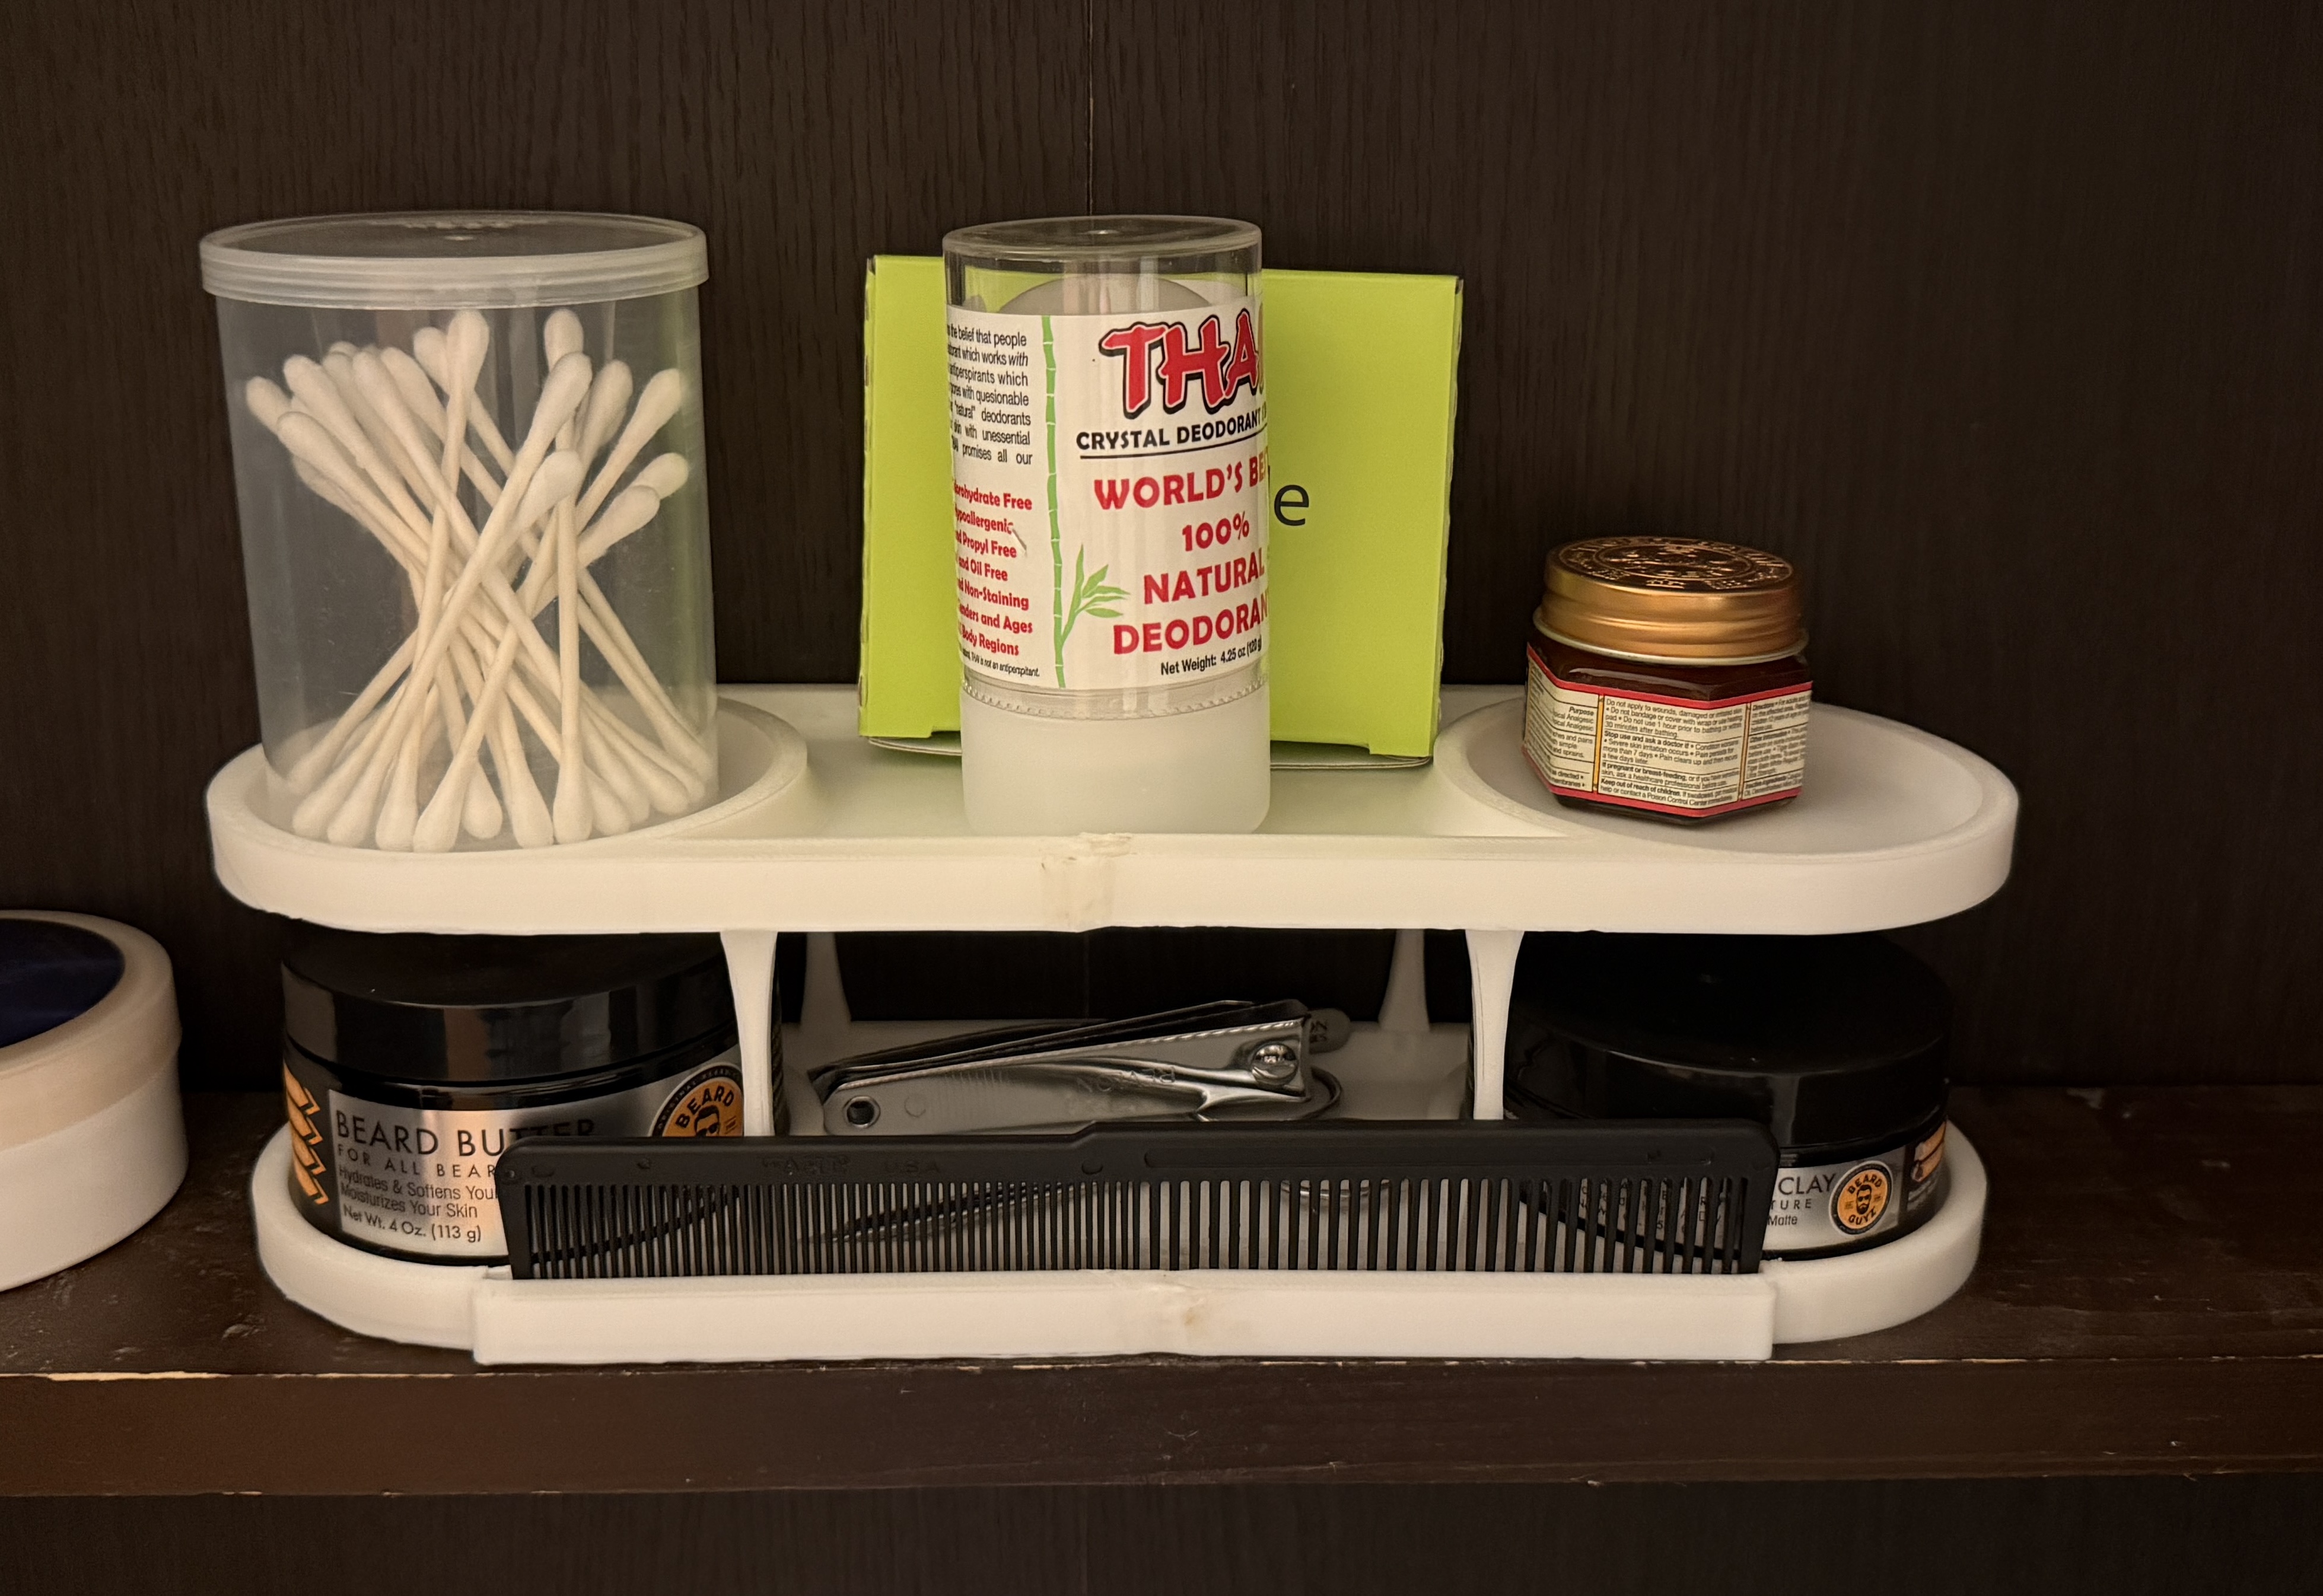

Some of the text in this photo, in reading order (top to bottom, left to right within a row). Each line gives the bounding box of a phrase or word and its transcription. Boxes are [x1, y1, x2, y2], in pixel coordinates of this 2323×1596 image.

[976, 328, 991, 344] that
[994, 332, 1027, 349] people
[962, 346, 980, 362] which
[981, 350, 1007, 365] works
[1008, 352, 1028, 367] with
[998, 371, 1028, 386] which
[962, 384, 1029, 406] with quesionable
[981, 407, 1031, 426] deodorants
[965, 423, 1030, 445] with unessential
[1076, 428, 1170, 450] CRYSTAL
[1177, 408, 1261, 444] DEODORANT
[962, 444, 1033, 465] promises all our
[1094, 461, 1243, 510] WORLD'S
[1003, 492, 1032, 510] Free
[1182, 511, 1250, 552] 100%
[962, 531, 1017, 558] Propyl Free
[970, 559, 982, 576] Oil
[984, 563, 1008, 581] Free
[1144, 547, 1265, 604] NATURAL
[964, 579, 1029, 611] Non-Staining
[981, 613, 1000, 628] and
[1003, 616, 1033, 634] Ages
[1113, 588, 1268, 655] DEODORAN
[979, 633, 1019, 656] Regions
[1161, 662, 1180, 676] Net
[1181, 654, 1217, 673] Weight:
[1220, 648, 1236, 664] 4.25
[1237, 647, 1246, 658] oz
[1566, 713, 1594, 724] Analgesic
[1569, 706, 1594, 716] Purpose
[1631, 711, 1656, 719] bandage
[1652, 706, 1677, 715] wounds,
[1679, 711, 1708, 719] damaged
[1566, 721, 1593, 731] Analgesic
[1654, 729, 1677, 739] bathing
[1605, 730, 1618, 738] Stop
[1662, 740, 1683, 748] doctor
[1609, 738, 1628, 747] Severe
[1633, 774, 1663, 783] healthcare
[1647, 793, 1666, 801] Poison
[1657, 787, 1681, 796] children.
[676, 1085, 734, 1128] BEARD
[336, 1110, 439, 1155] BEARD
[338, 1144, 371, 1166] FOR
[384, 1159, 421, 1176] ALL
[340, 1165, 388, 1192] Hydrates
[393, 1179, 403, 1194] &
[408, 1181, 462, 1200] Softens
[1778, 1173, 1837, 1196] CLAY
[1847, 1174, 1882, 1194] BEARD
[341, 1183, 478, 1218] Moisturizes Your Skin
[343, 1204, 481, 1243] Net Wt. 4 Oz. (113 g)
[1768, 1215, 1797, 1227] Matte
[1848, 1206, 1876, 1225] GUYZ
